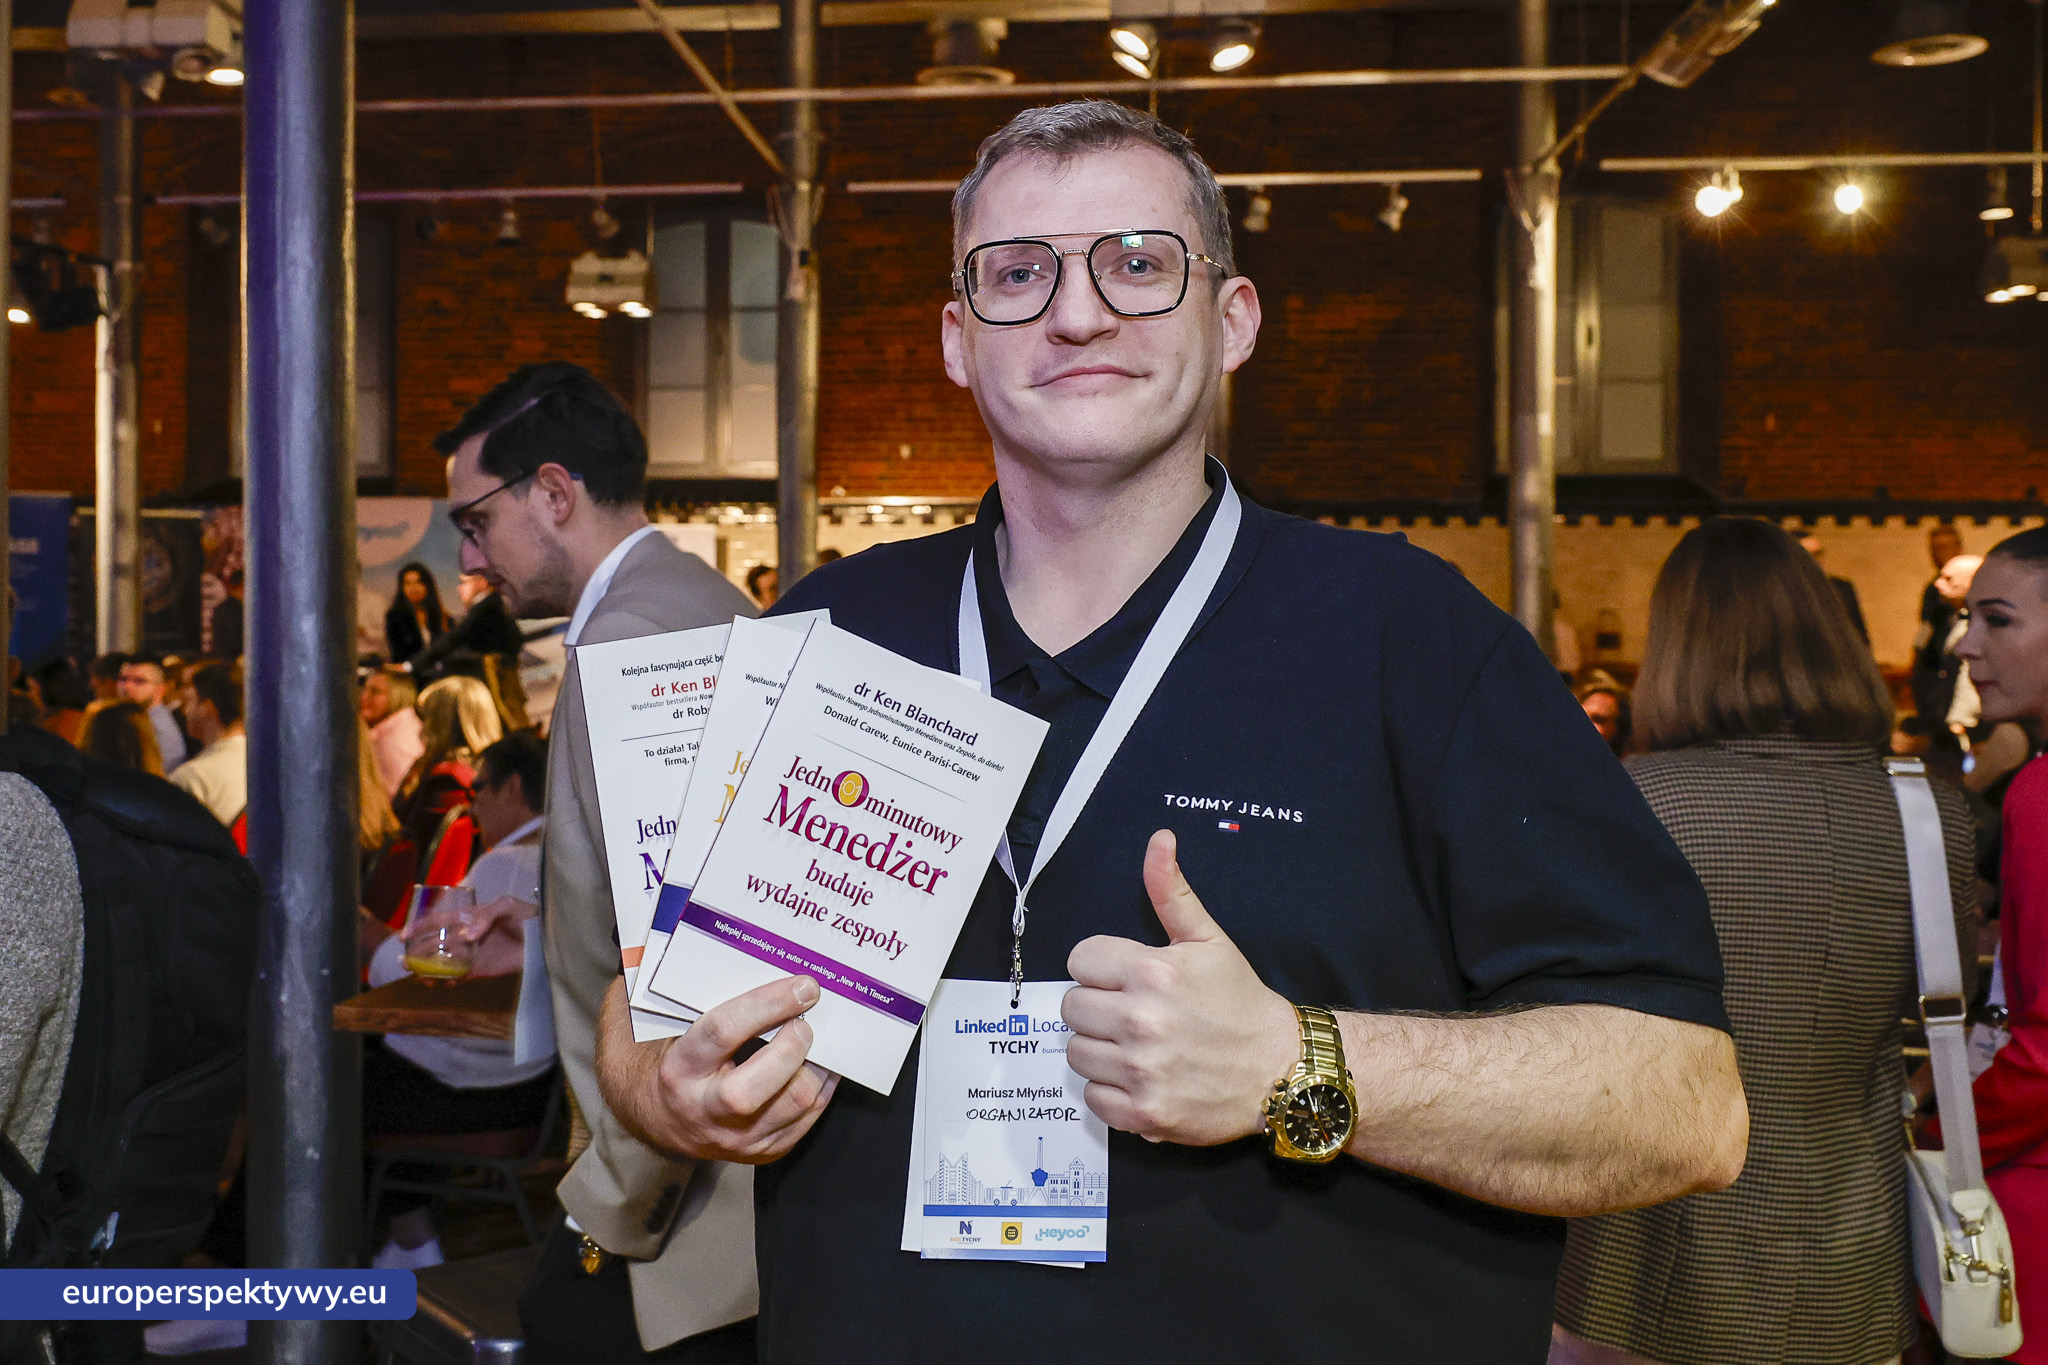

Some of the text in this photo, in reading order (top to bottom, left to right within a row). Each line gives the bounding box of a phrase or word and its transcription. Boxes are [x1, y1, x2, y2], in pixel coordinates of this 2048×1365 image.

[622, 666, 649, 676] Kolejna
[650, 658, 693, 672] fascynująca
[694, 655, 714, 666] część
[651, 684, 666, 697] dr
[671, 681, 698, 694] Ken
[631, 700, 664, 711] Współautor
[666, 696, 698, 706] bestsellera
[672, 705, 709, 719] dr Rob
[854, 682, 979, 746] dr Ken Blanchard
[816, 682, 846, 701] Współautor
[846, 696, 868, 711] Nowego
[867, 706, 915, 732] Jednominutowego
[944, 741, 955, 751] oraz
[978, 756, 986, 764] do
[657, 744, 685, 756] działa!
[823, 705, 981, 782] Donald Carew, Eunice Parisi-Carew
[664, 756, 690, 766] firmą,
[1164, 794, 1303, 823] TOMMY JEANS
[636, 815, 677, 844] Jedn
[763, 783, 948, 896] Menedżer
[805, 859, 874, 907] buduje
[746, 874, 909, 961] wydajne zespoły
[714, 920, 742, 939] Najlepiej
[741, 933, 777, 955] sprzedający
[776, 948, 786, 959] się
[786, 952, 803, 965] autor
[803, 960, 810, 968] w
[810, 963, 837, 980] rankingu
[855, 981, 869, 994] York
[1033, 1018, 1073, 1033] Loca
[989, 1041, 1039, 1054] TYCHY
[968, 1087, 1063, 1101] Mariusz Młyński
[966, 1107, 1081, 1122] ORGANIZATOR
